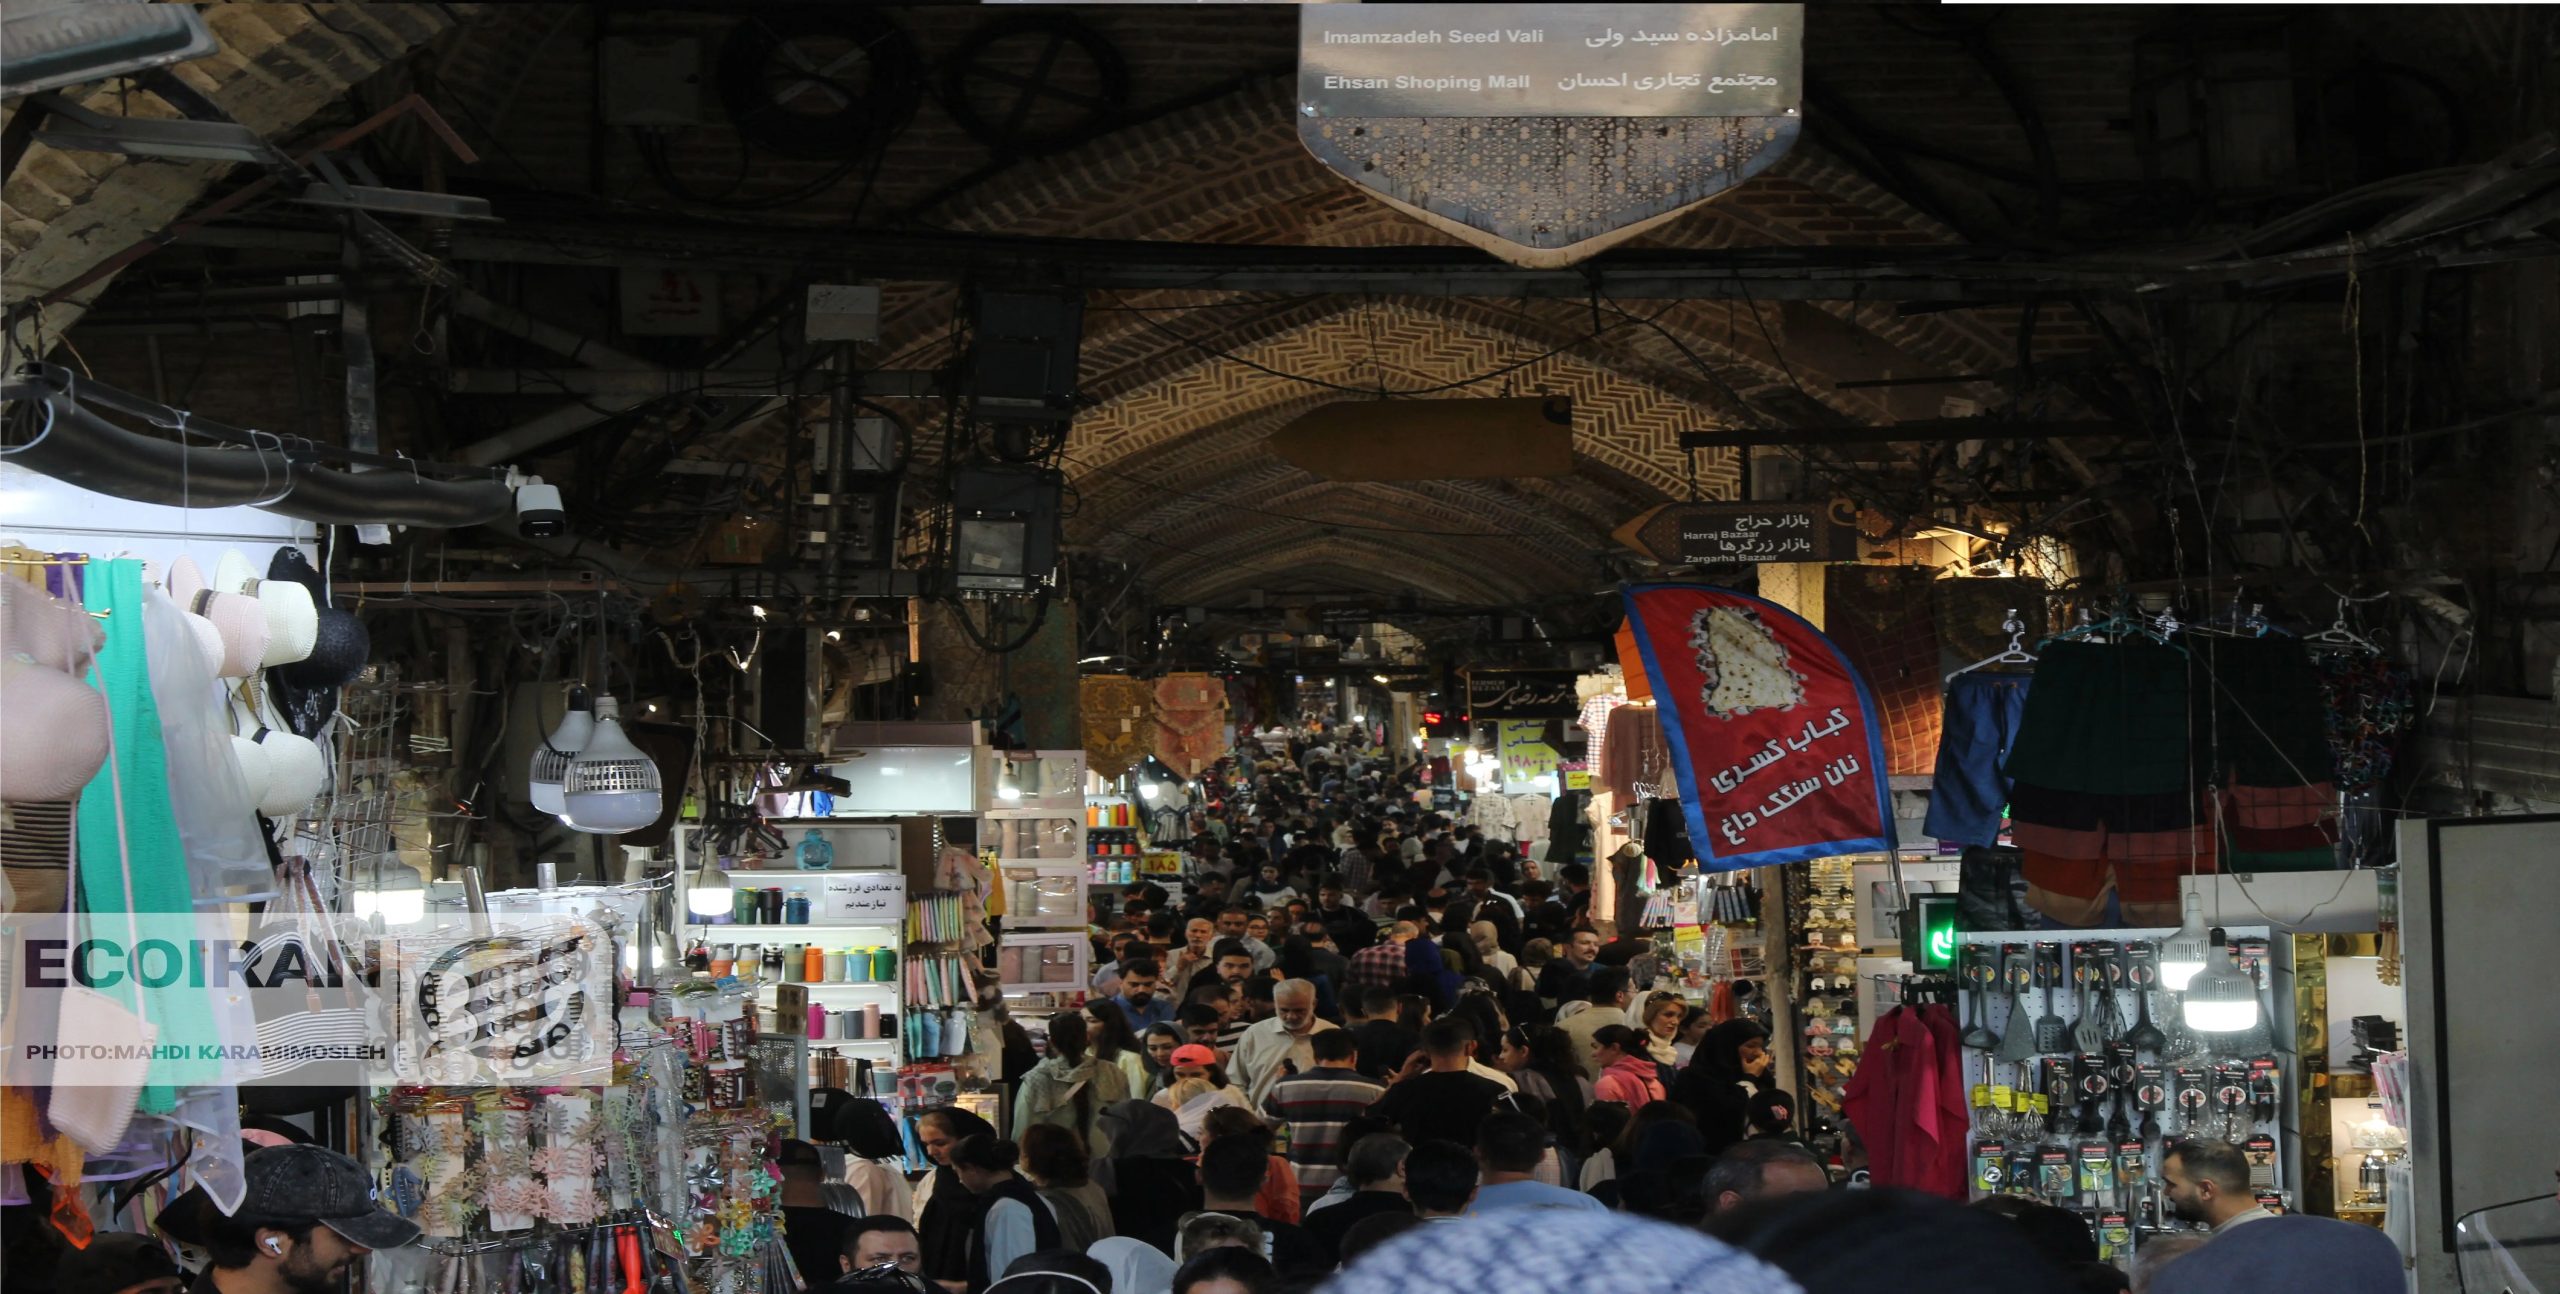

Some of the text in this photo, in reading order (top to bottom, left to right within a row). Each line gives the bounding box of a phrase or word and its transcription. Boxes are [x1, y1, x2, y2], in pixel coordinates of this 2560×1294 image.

[1323, 29, 1544, 44] Imamzadeh Seed Vali
[1585, 26, 1778, 48] امامزاده سید ولی
[1323, 75, 1530, 93] Ehsan Shoping Mall
[1557, 72, 1778, 94] مجتمع تجاری احسان
[1735, 514, 1810, 532] بازار حراج
[1683, 530, 1760, 541] Harraj Bazaar
[1719, 538, 1811, 555] بازار زرگرها
[1684, 554, 1779, 565] Zargarha Bazaar
[1710, 707, 1851, 795] کباب کسری
[1720, 754, 1861, 847] نان سنگک داغ
[828, 883, 902, 894] به تعدادی فروشنده
[845, 899, 887, 911] نیازمندیم
